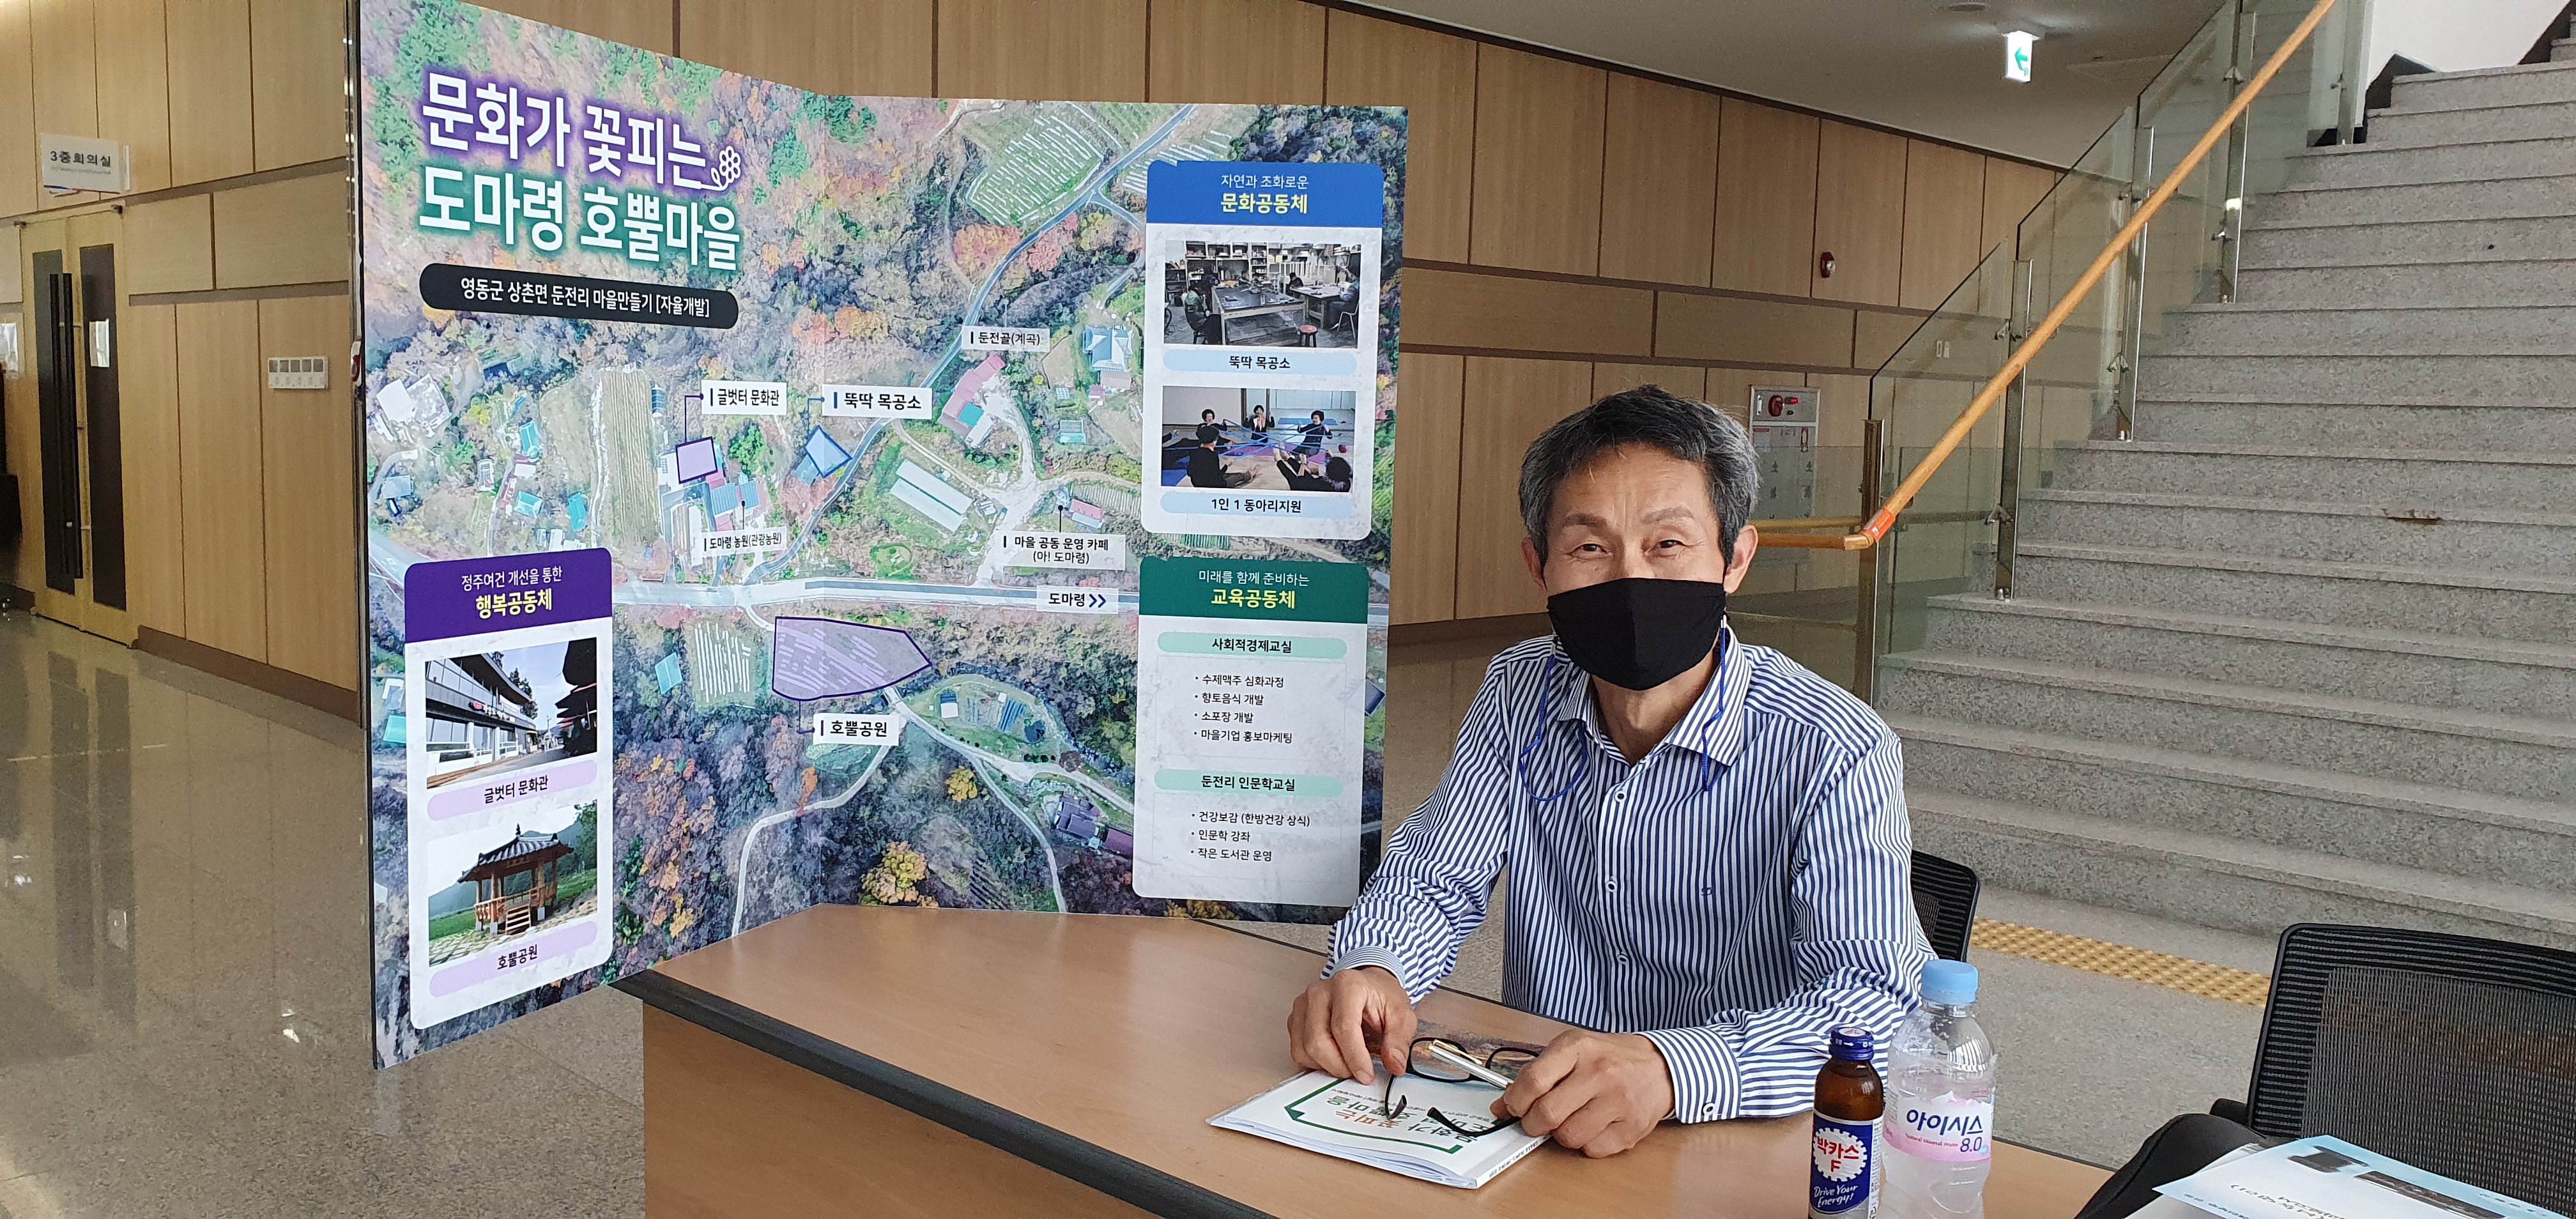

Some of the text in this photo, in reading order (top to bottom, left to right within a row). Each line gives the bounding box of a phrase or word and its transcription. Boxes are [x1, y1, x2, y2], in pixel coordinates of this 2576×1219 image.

[423, 73, 707, 191] 문화가 꽃피는
[50, 151, 111, 167] 3중회의실
[1221, 174, 1308, 189] 자연과 조화로운
[1221, 193, 1307, 214] 문화공동체
[419, 165, 740, 271] 도마령 호뿔마을
[461, 277, 709, 318] 영동군 상촌면 둔전리 마을만들기 [자율개발]
[978, 332, 1040, 346] 둔전골(계곡)
[1229, 355, 1291, 369] 뚝딱 목공소
[717, 388, 780, 408] 글벗터 문화관
[844, 392, 921, 410] 뚝딱 목공소
[1211, 498, 1230, 510] 1인
[1243, 498, 1301, 513] 동아리지원
[709, 533, 781, 549] 도마령 농원(관광농원)
[1015, 536, 1108, 550] 마을 공동 운영 카페
[1033, 551, 1089, 564] (아! 도마령)
[462, 566, 562, 592] 정주여건 개선을 통한
[1199, 571, 1309, 586] 미래를 함께 준비하는
[476, 588, 553, 619] 행복공동체
[1049, 593, 1085, 607] 도마령
[1211, 589, 1295, 609] 교육공동체
[1212, 638, 1292, 654] 사회적경제교실
[1202, 674, 1284, 688] 수제맥주 심화과정
[1202, 693, 1264, 705] 향토음식 개발
[1202, 711, 1253, 724] 소포장 개발
[830, 721, 887, 737] 호뿔공원
[1201, 729, 1292, 744] 마을기업 홍보마케팅
[484, 775, 549, 804] 글벗터 문화관
[1202, 776, 1295, 791] 둔전리 인문학교실
[1199, 811, 1310, 827] 건강보감 (한방건강 상식)
[1199, 829, 1250, 843] 인문학 강좌
[1198, 848, 1272, 862] 작은 도서관 운영
[497, 944, 537, 970] 호뿔공원
[1906, 1110, 1983, 1136] 아이시스
[1817, 1137, 1859, 1159] 박카스
[1960, 1137, 1982, 1152] 8.0
[1831, 1160, 1841, 1172] F
[1814, 1186, 1836, 1197] Drive
[1818, 1193, 1854, 1208] Energy!
